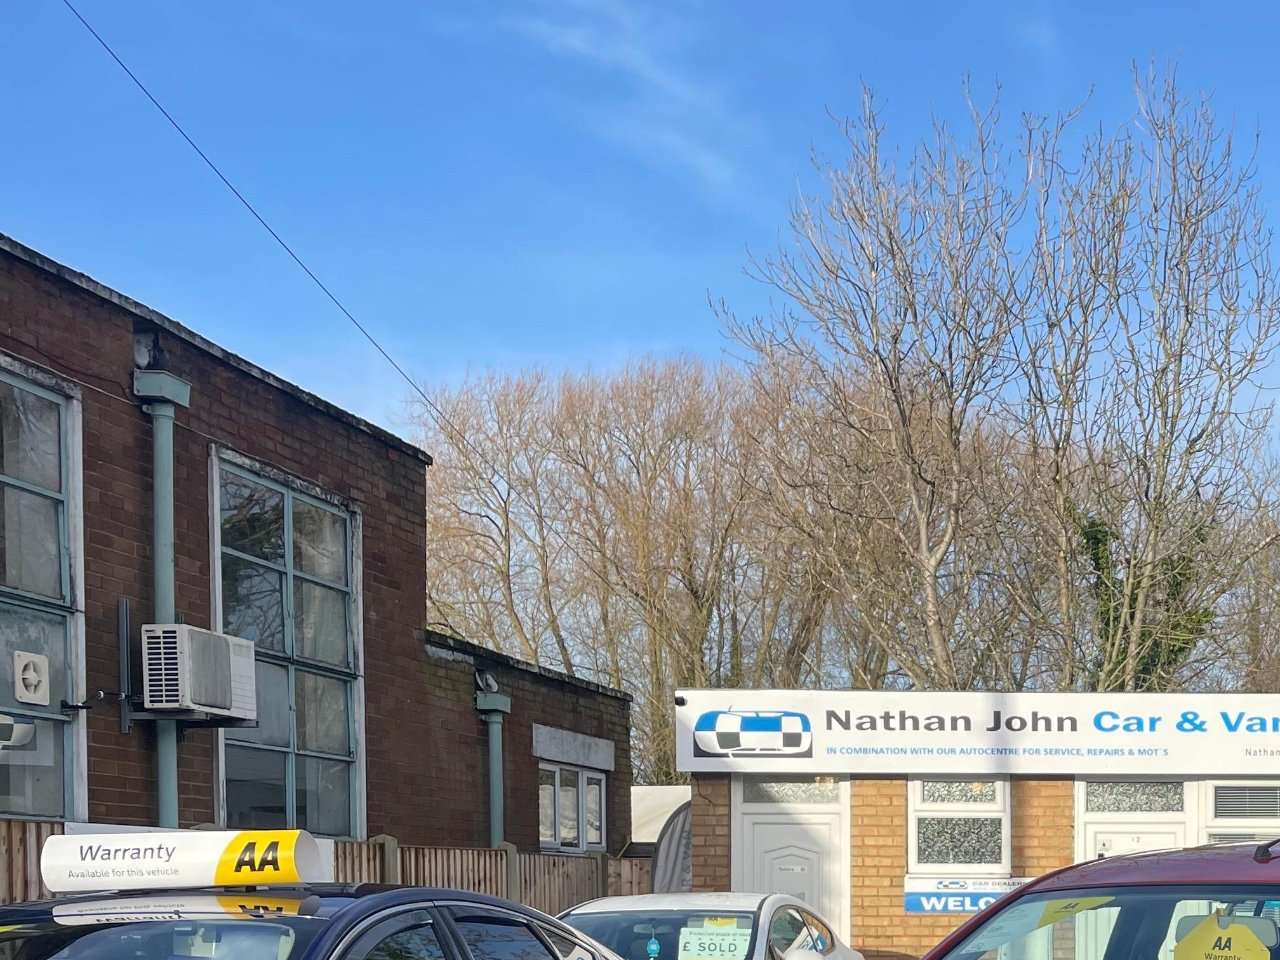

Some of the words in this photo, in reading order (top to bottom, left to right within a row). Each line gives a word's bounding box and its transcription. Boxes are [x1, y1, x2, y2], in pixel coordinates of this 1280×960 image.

[825, 709, 972, 732] Nathan
[986, 709, 1078, 732] John
[1093, 711, 1162, 733] Car
[1176, 711, 1207, 733] &
[826, 746, 837, 755] IN
[839, 746, 907, 756] COMBINATION
[909, 747, 934, 756] WITH
[936, 747, 957, 756] OUR
[959, 747, 1018, 756] AUTOCENTRE
[1022, 747, 1041, 757] FOR
[1043, 747, 1085, 758] SERVICE,
[1087, 748, 1125, 757] REPAIRS
[1127, 748, 1135, 757] &
[79, 843, 177, 863] Warranty
[234, 841, 280, 873] AA
[68, 869, 110, 879] Available
[112, 868, 125, 878] for
[127, 868, 144, 877] this
[146, 867, 179, 877] vehicle
[683, 941, 691, 951] £
[697, 942, 737, 952] SOLD
[1212, 936, 1233, 951] AA
